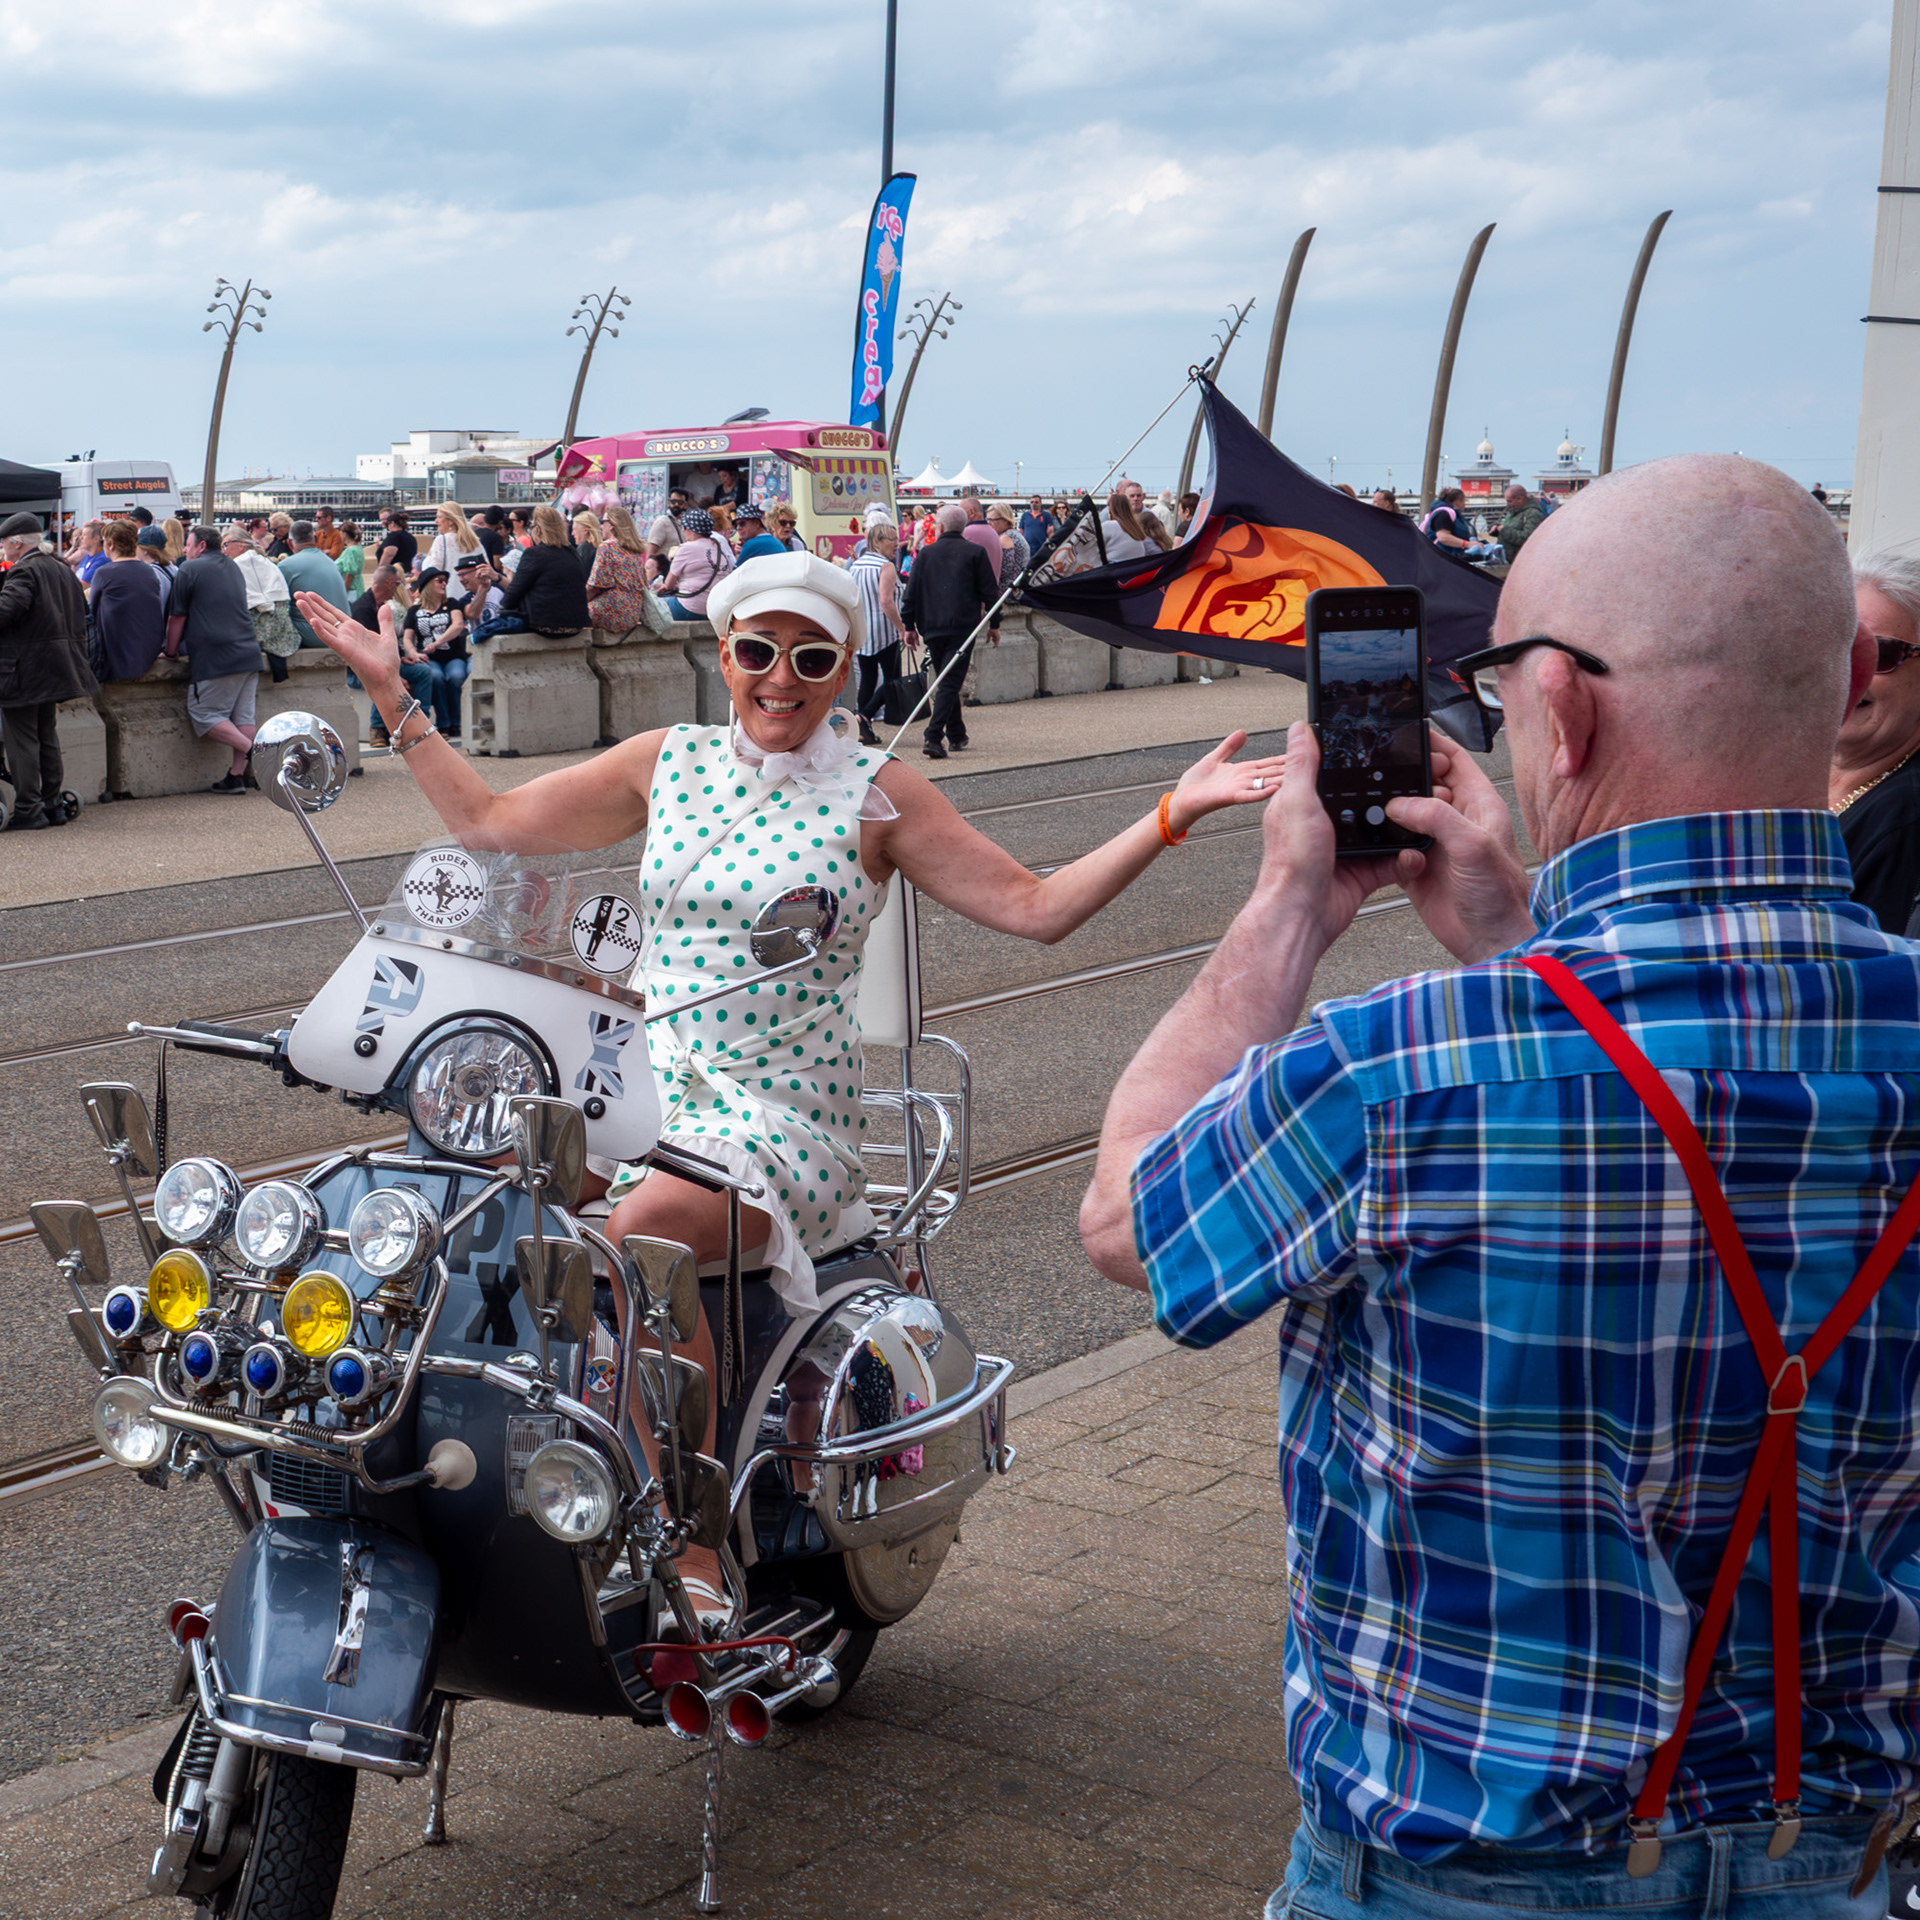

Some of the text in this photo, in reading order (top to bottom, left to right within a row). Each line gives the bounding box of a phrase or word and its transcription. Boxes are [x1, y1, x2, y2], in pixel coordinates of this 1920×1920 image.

[656, 439, 718, 453] RUOCCO'S
[102, 480, 166, 491] Street Angels
[430, 854, 469, 869] RUDER
[415, 905, 470, 924] THAN YOU
[614, 907, 630, 928] 2
